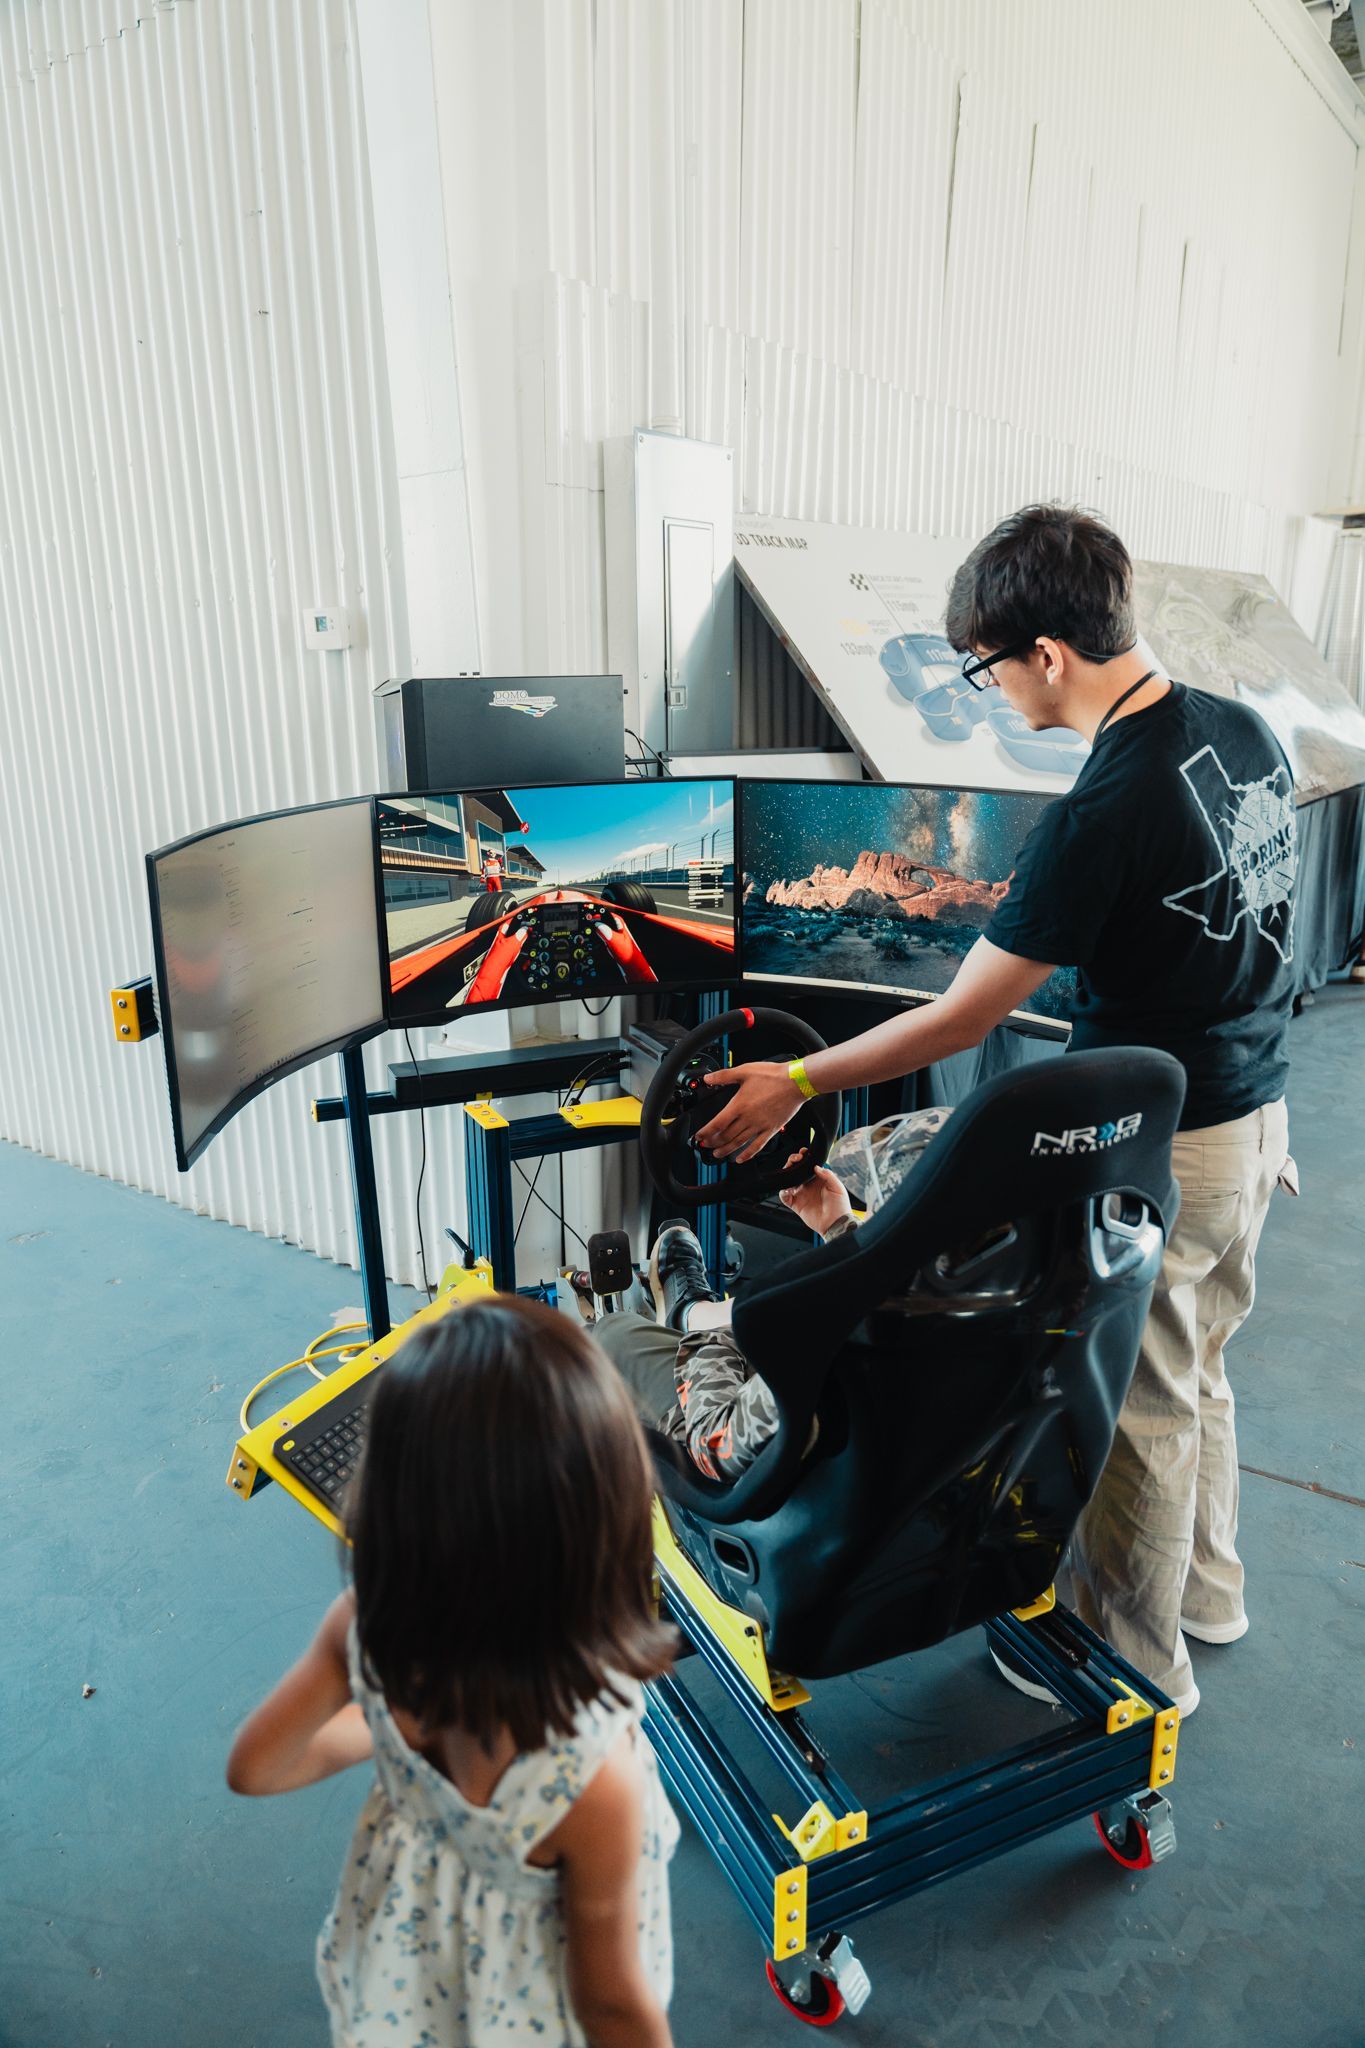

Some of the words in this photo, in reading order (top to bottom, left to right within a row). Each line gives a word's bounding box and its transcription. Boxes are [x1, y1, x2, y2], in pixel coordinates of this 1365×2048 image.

[748, 533, 787, 549] TRACK
[785, 536, 809, 551] MAP
[1236, 841, 1251, 861] THE
[1256, 846, 1291, 879] COMPA
